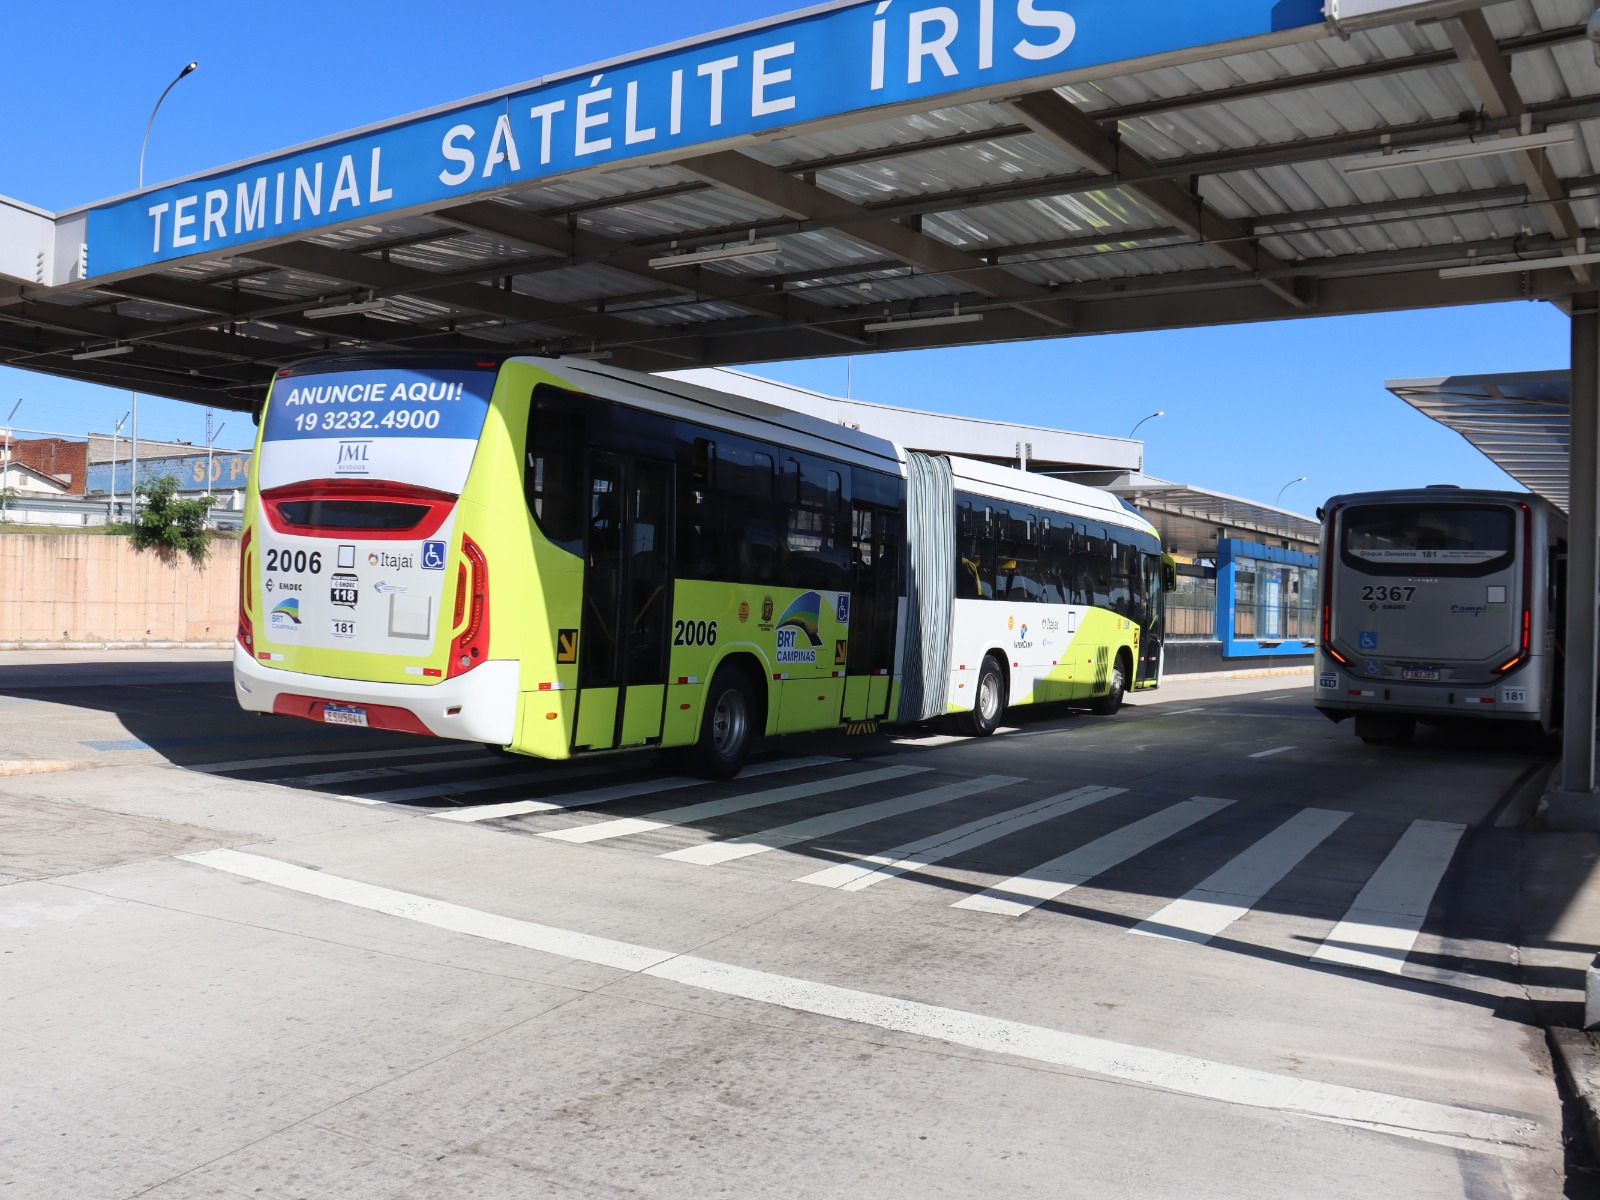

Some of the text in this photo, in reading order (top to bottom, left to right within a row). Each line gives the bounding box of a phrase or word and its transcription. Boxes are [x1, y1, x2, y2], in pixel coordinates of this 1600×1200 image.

[148, 0, 1076, 254] TERMINAL SATÉLITE ÍRIS
[285, 382, 465, 407] ANUNCIE AQUI!
[294, 409, 441, 431] 19 3232.4900
[336, 444, 370, 465] JML
[266, 548, 323, 575] 2006
[379, 551, 414, 571] Itajaí
[1360, 550, 1383, 558] Disque
[1384, 549, 1417, 558] Denúncia
[278, 582, 303, 592] EMDEC
[333, 589, 356, 602] 118
[1361, 585, 1416, 602] 2367
[271, 614, 284, 623] BRT
[271, 623, 298, 631] CAMPINAS
[334, 622, 355, 634] 181
[674, 620, 717, 646] 2006
[777, 630, 797, 648] BRT
[776, 650, 816, 663] CAMPINAS
[1504, 692, 1524, 701] 181
